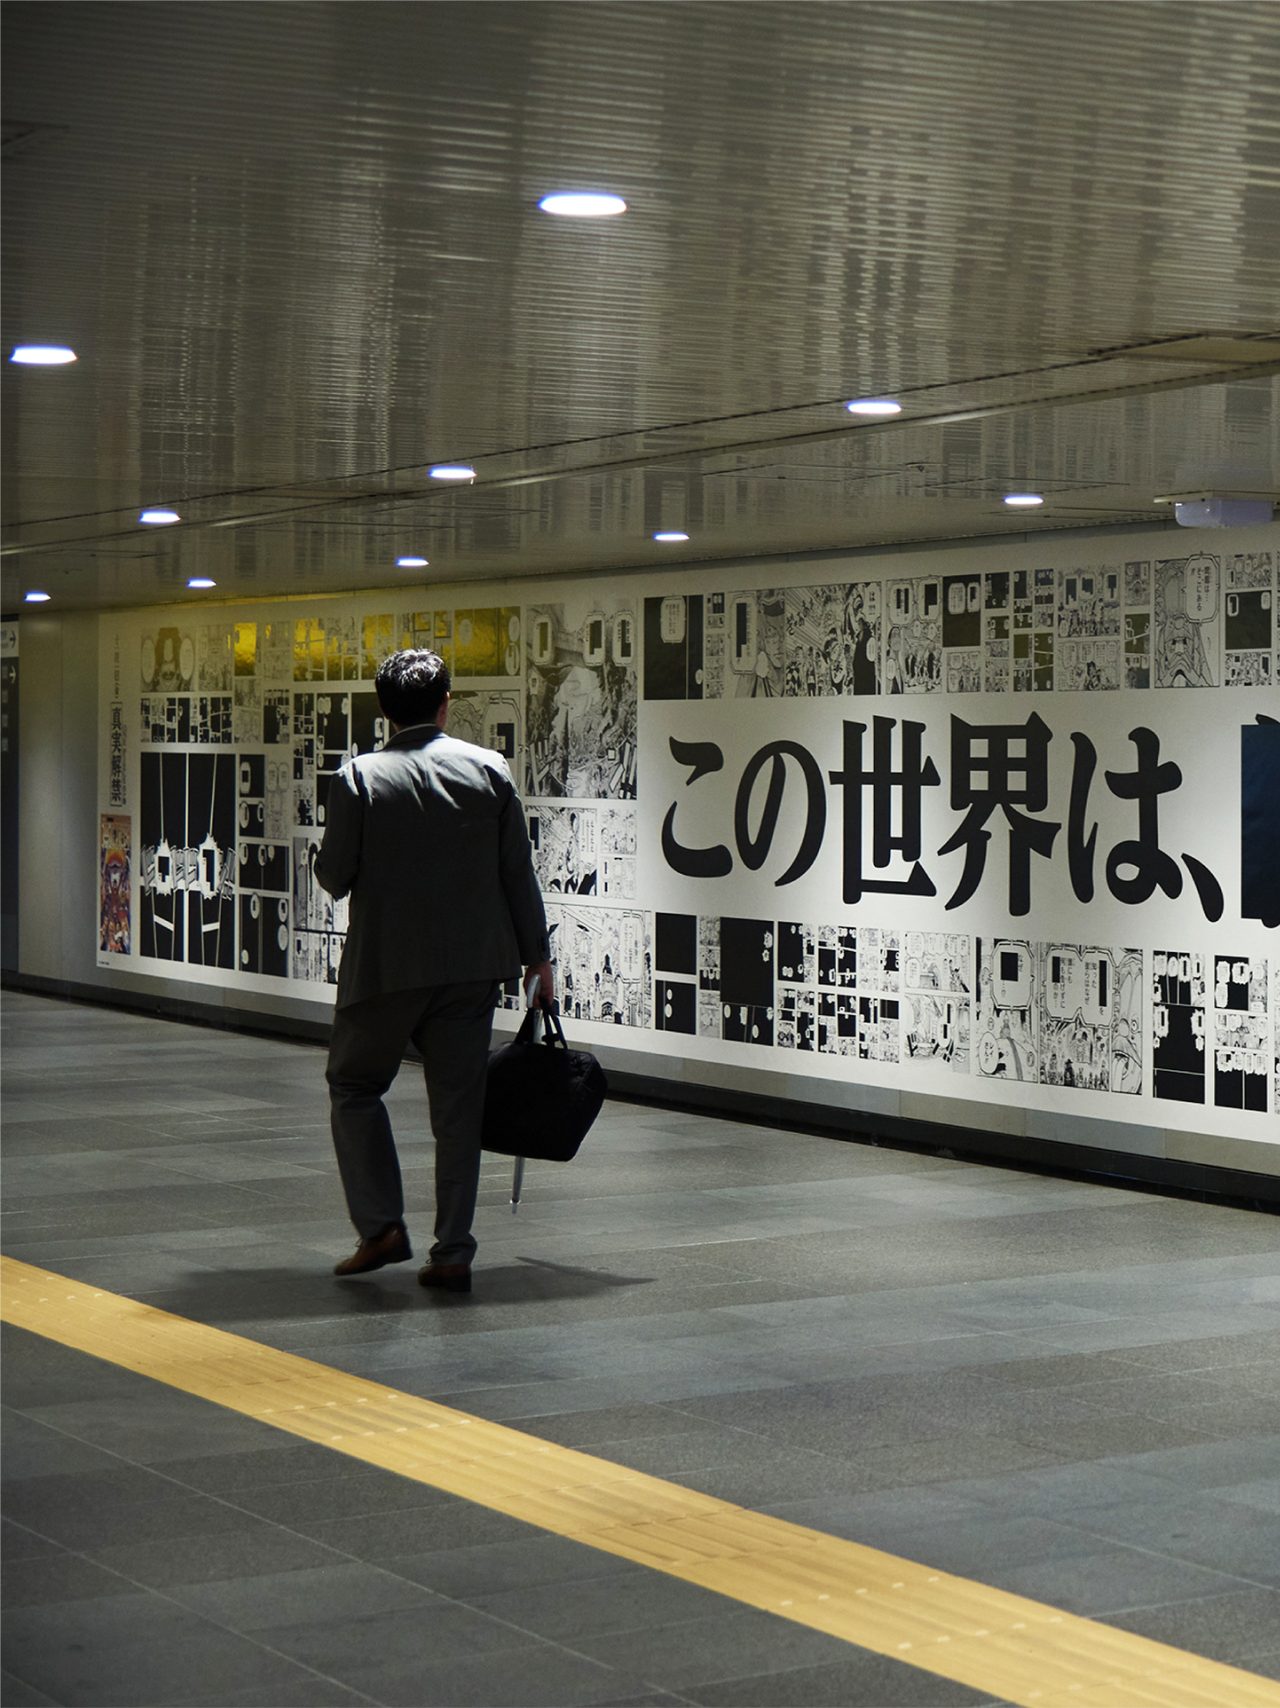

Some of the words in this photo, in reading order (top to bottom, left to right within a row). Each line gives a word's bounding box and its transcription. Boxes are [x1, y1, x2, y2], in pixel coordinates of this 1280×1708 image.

[661, 711, 1225, 924] この世界は、
